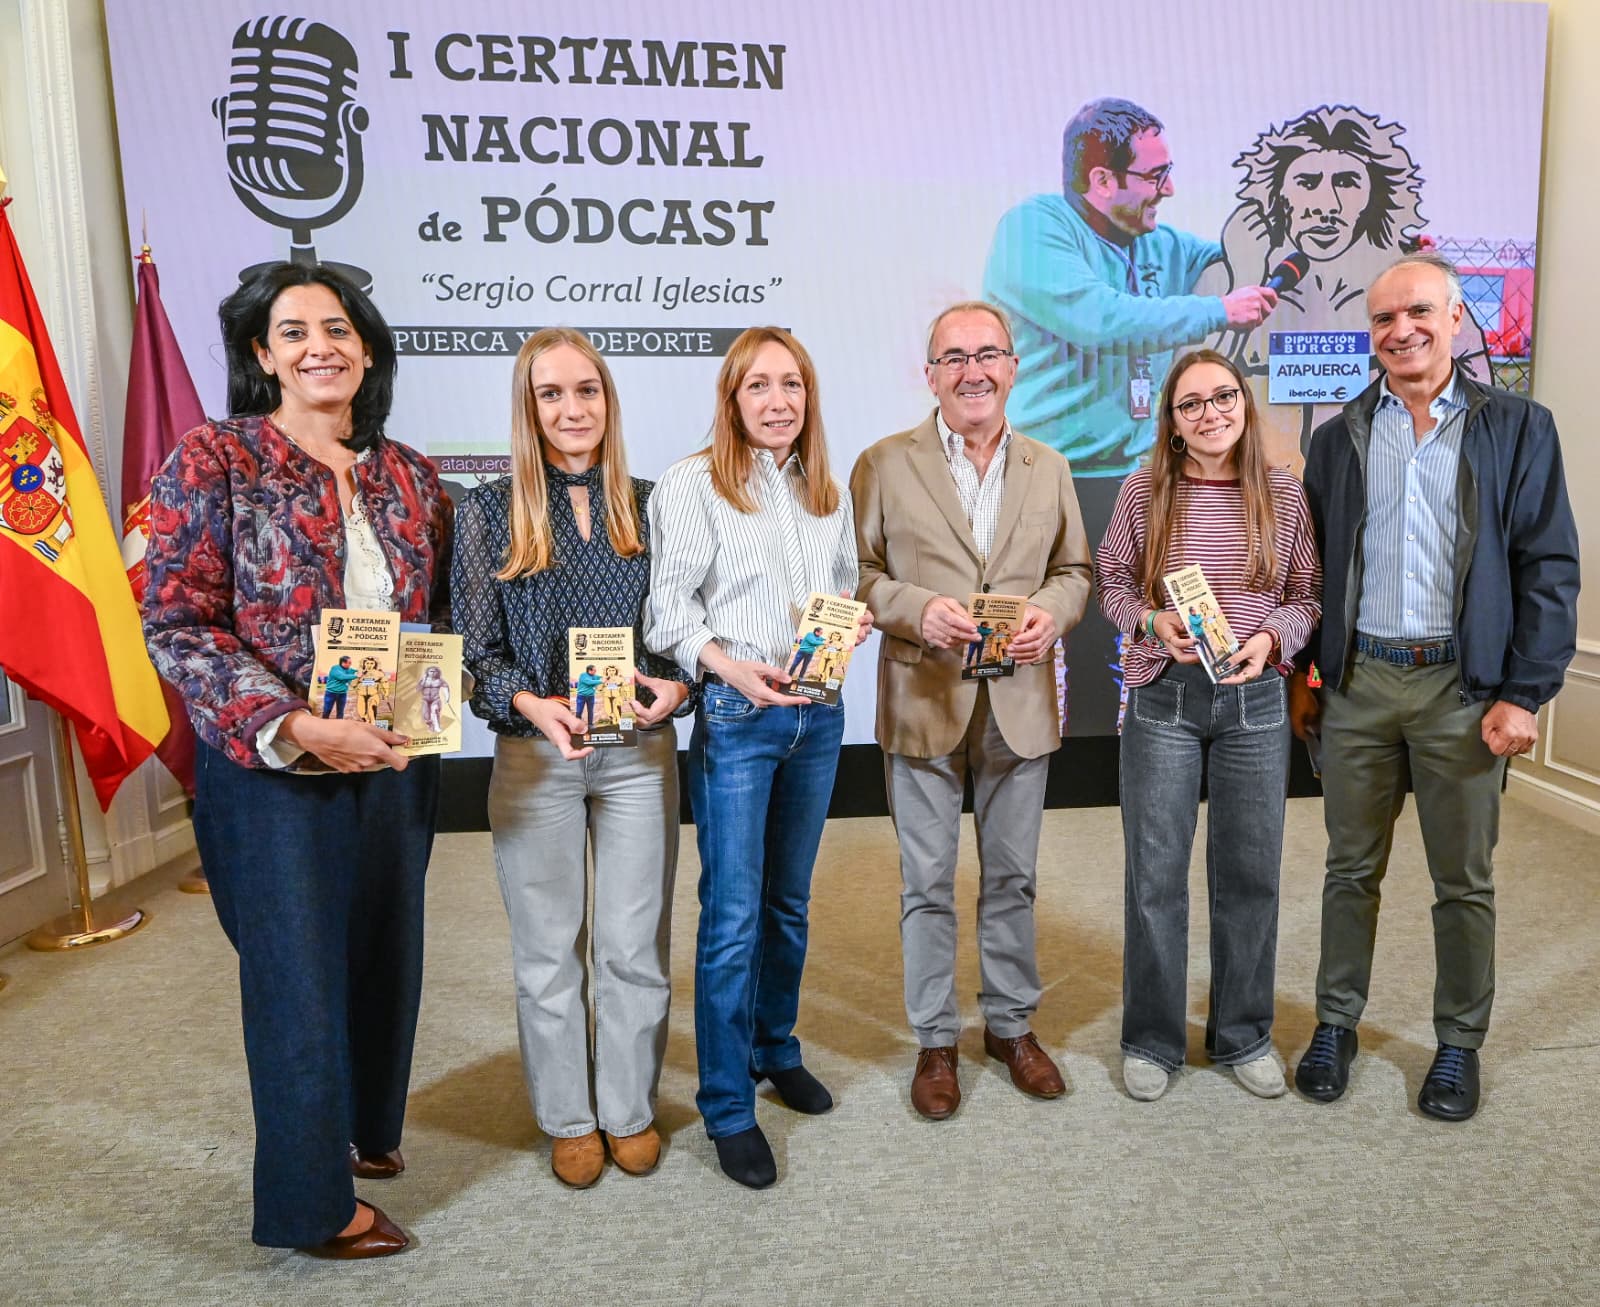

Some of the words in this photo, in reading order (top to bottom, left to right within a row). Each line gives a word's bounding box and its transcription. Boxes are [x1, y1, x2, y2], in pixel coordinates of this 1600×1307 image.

[387, 31, 413, 79] I
[435, 32, 787, 90] CERTAMEN
[421, 113, 764, 168] NACIONAL
[418, 211, 463, 242] de
[481, 182, 775, 246] PÓDCAST
[545, 275, 642, 303] Corral
[393, 331, 510, 352] PUERCA
[588, 331, 714, 353] DEPORTE
[1284, 334, 1356, 344] DIPUTACIÓN
[1284, 343, 1356, 353] BURGOS
[1277, 363, 1362, 377] ATAPUERCA
[441, 458, 513, 472] atapuerc
